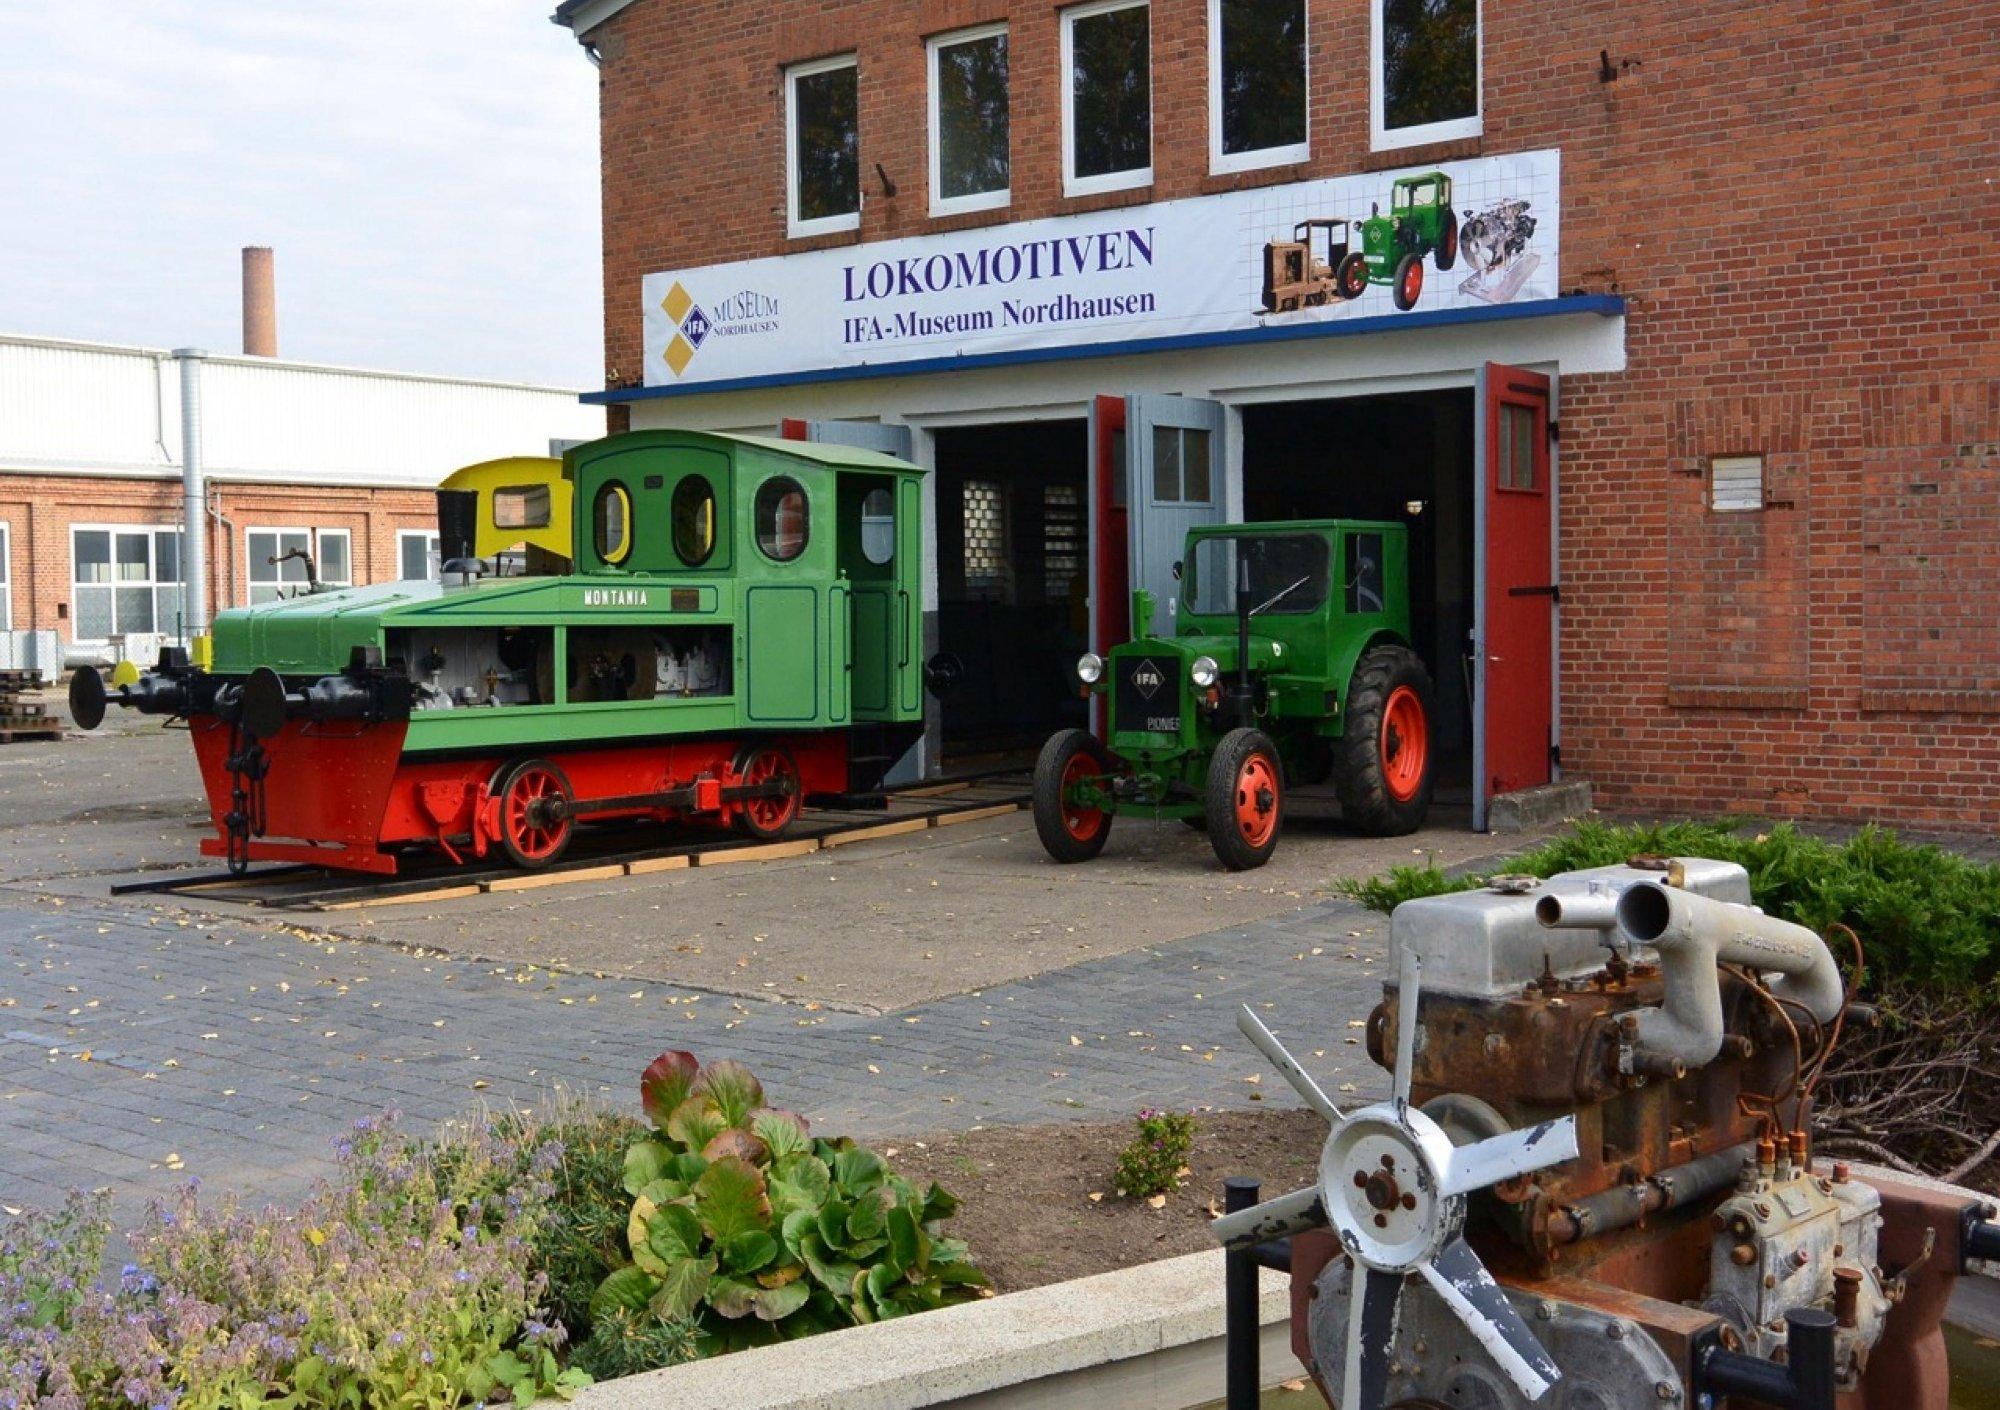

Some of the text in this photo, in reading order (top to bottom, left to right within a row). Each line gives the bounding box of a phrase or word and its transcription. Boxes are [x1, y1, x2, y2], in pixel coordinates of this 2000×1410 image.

[843, 227, 1155, 302] LOKOMOTIVEN
[713, 290, 779, 323] MUSEUM
[843, 291, 1155, 343] IFA-Museum Nordhausen
[687, 320, 705, 335] IFA
[713, 320, 779, 338] NORDHAUSEN
[584, 588, 648, 606] MONTANIA
[1136, 673, 1158, 685] IFA
